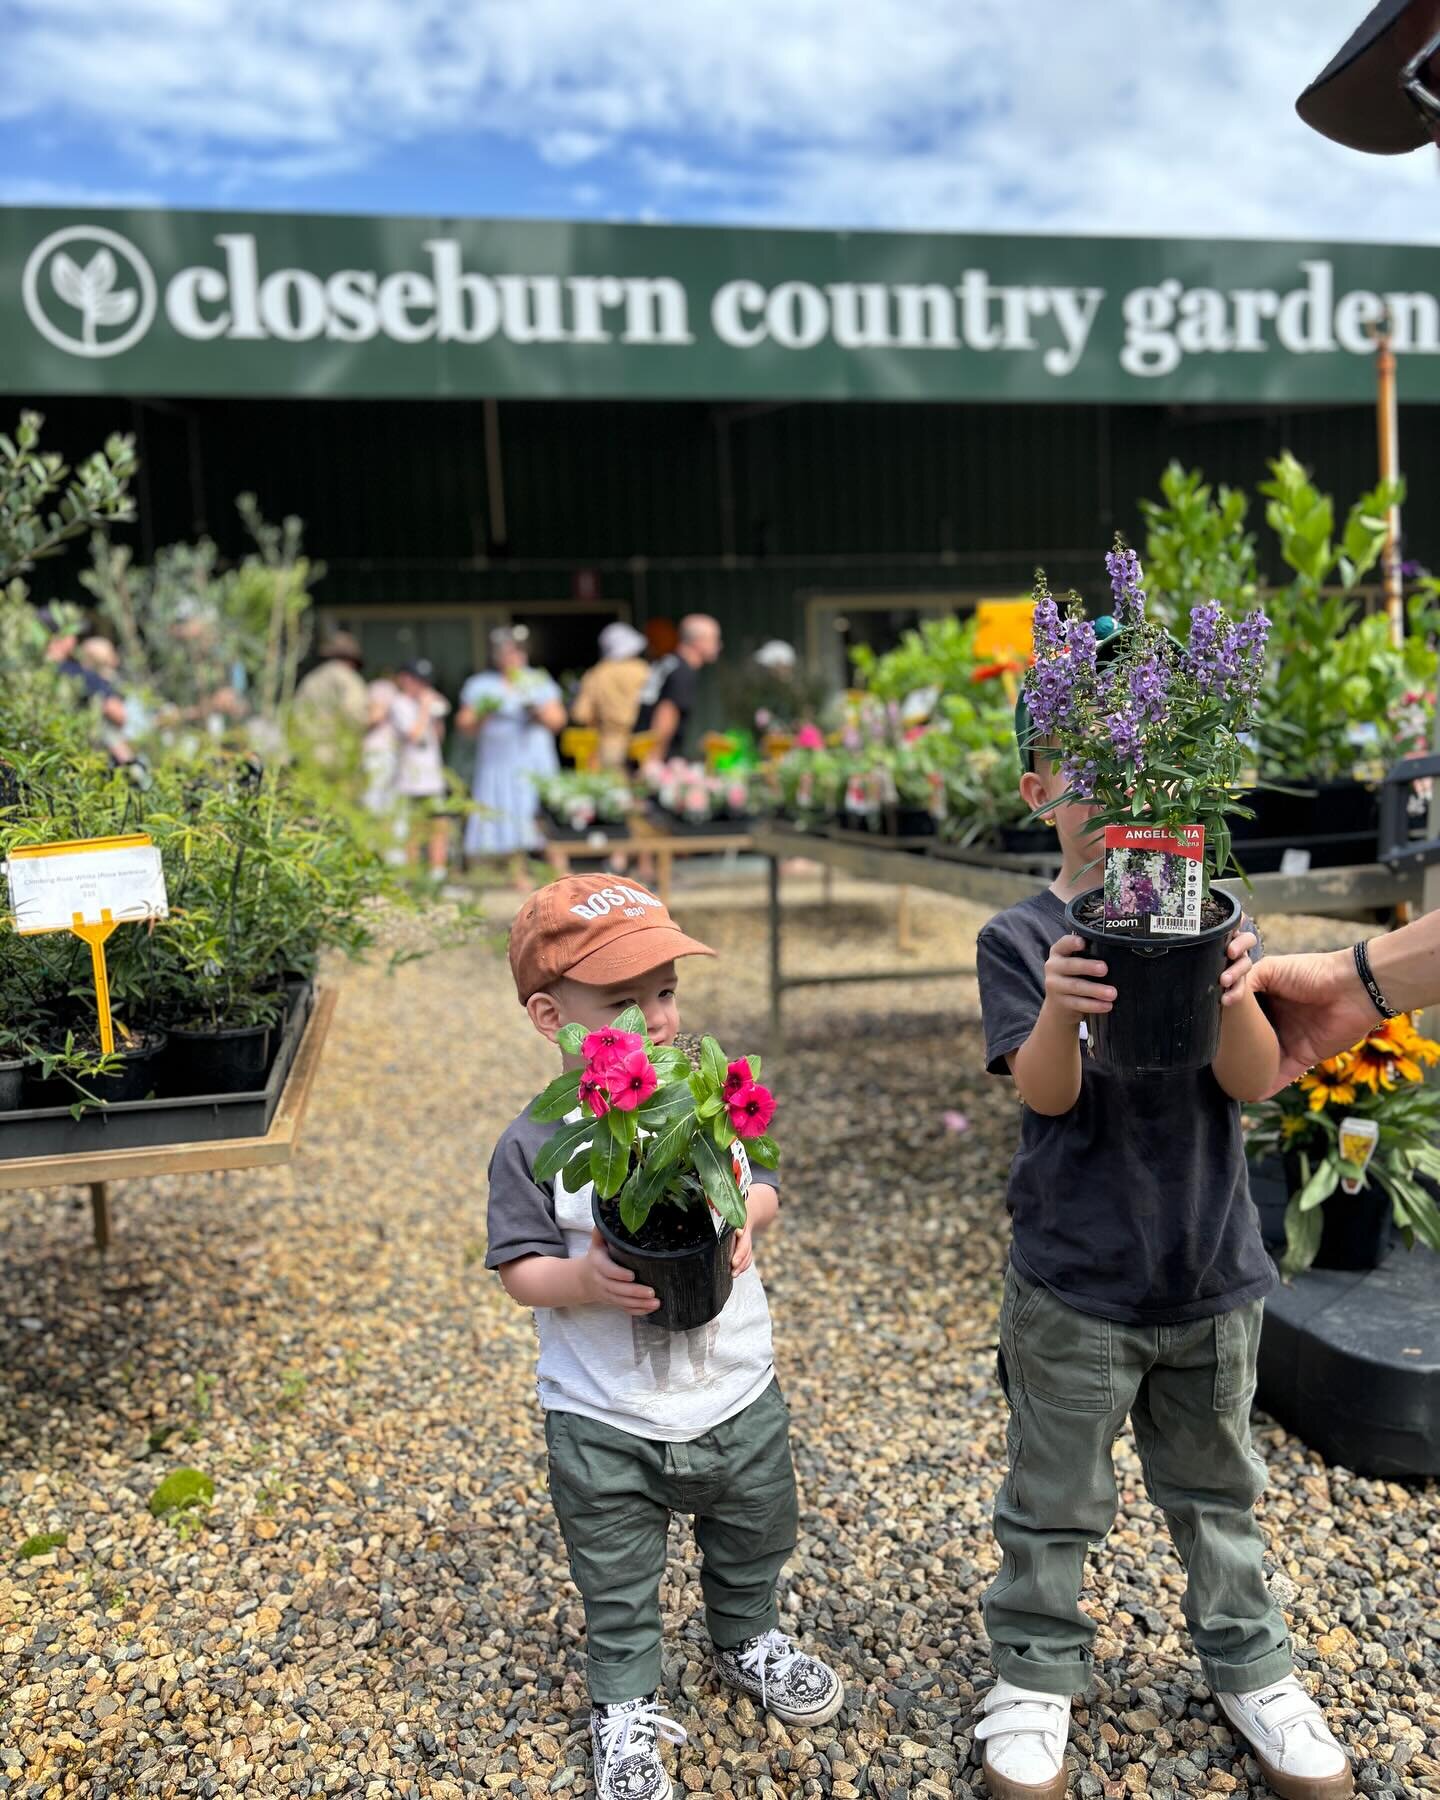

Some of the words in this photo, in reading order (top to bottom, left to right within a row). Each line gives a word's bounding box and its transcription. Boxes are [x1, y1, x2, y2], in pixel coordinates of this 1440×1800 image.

[165, 233, 696, 344] closeburn
[711, 269, 1105, 375] country
[1120, 260, 1440, 377] garden
[1125, 830, 1200, 839] ANGELOIA
[623, 906, 646, 918] 1830
[1106, 918, 1138, 928] zoom
